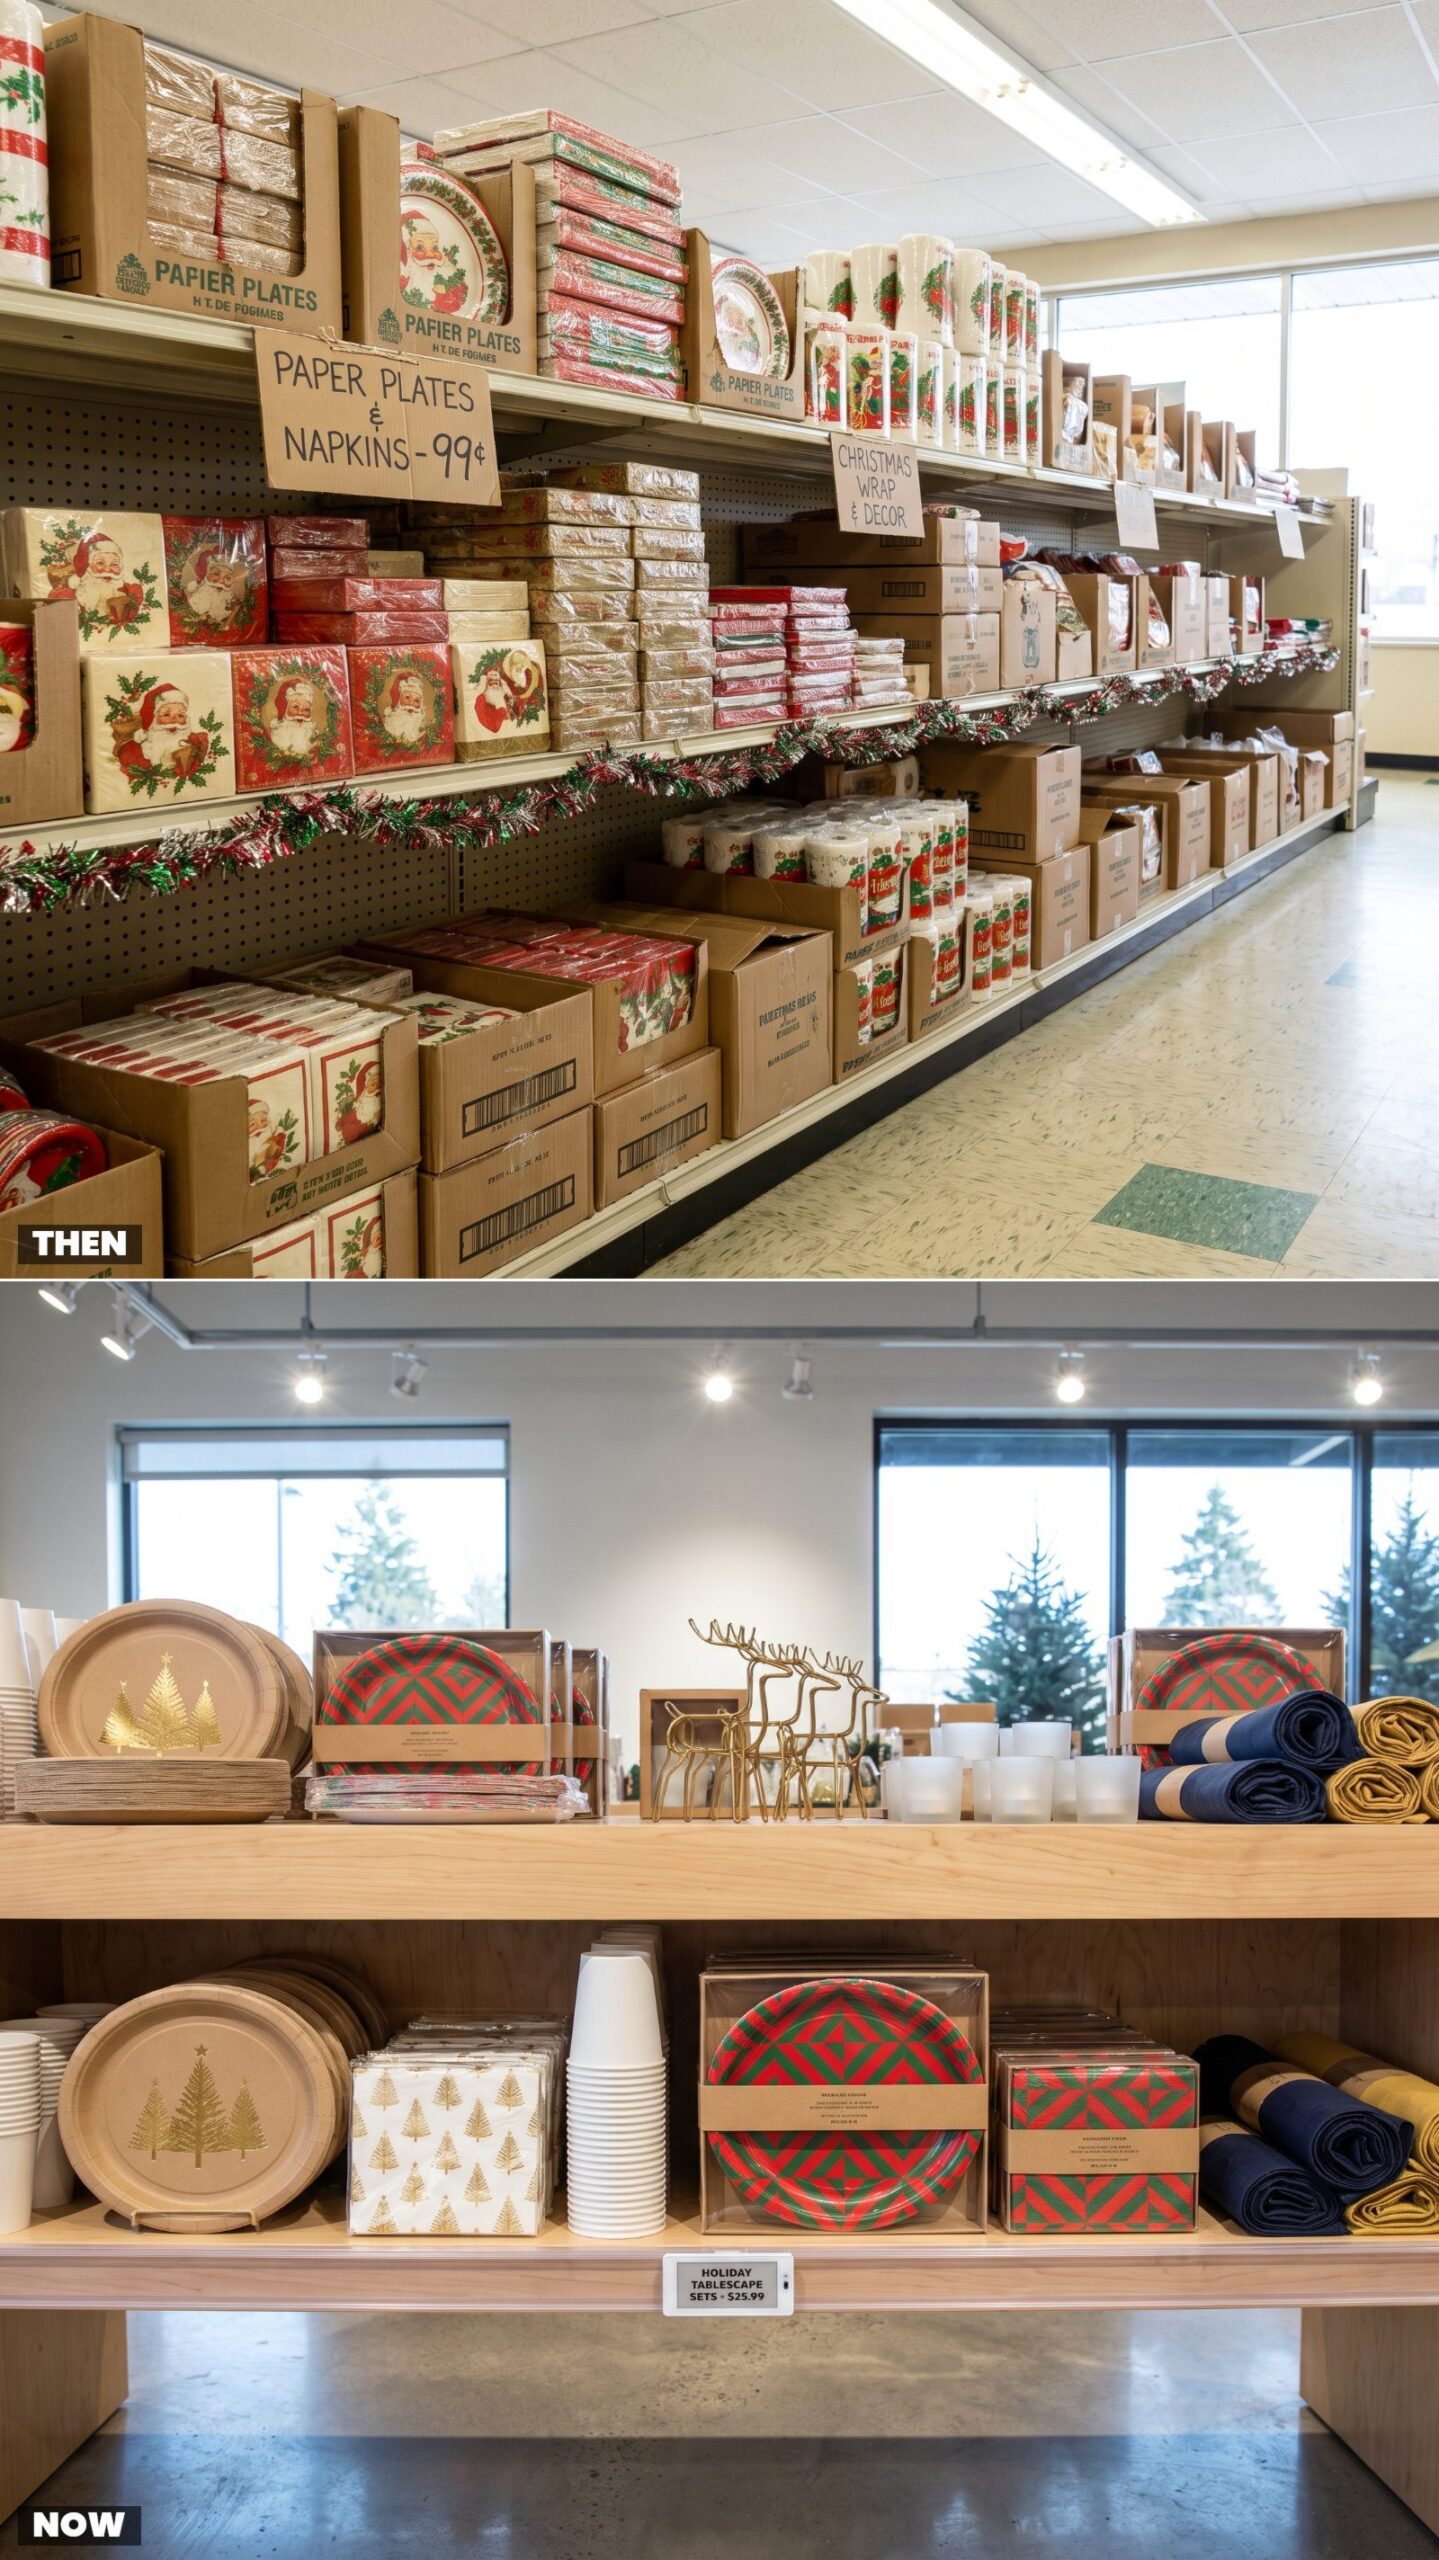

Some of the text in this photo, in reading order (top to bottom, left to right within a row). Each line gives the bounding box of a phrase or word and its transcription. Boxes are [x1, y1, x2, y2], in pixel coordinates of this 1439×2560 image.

[215, 298, 231, 312] DE
[243, 276, 318, 312] PLATES
[467, 326, 521, 355] PLATES
[274, 350, 475, 413] PAPER PLATES
[764, 382, 794, 402] PLATES
[369, 400, 384, 433] &
[838, 444, 913, 478] CHRISTMAS
[856, 475, 896, 501] WRAP
[851, 501, 907, 529] & DECOR
[691, 2280, 763, 2290] TABLESCAPE
[701, 2268, 752, 2278] HOLIDAY
[689, 2292, 718, 2301] SETS
[727, 2291, 765, 2302] $25.99
